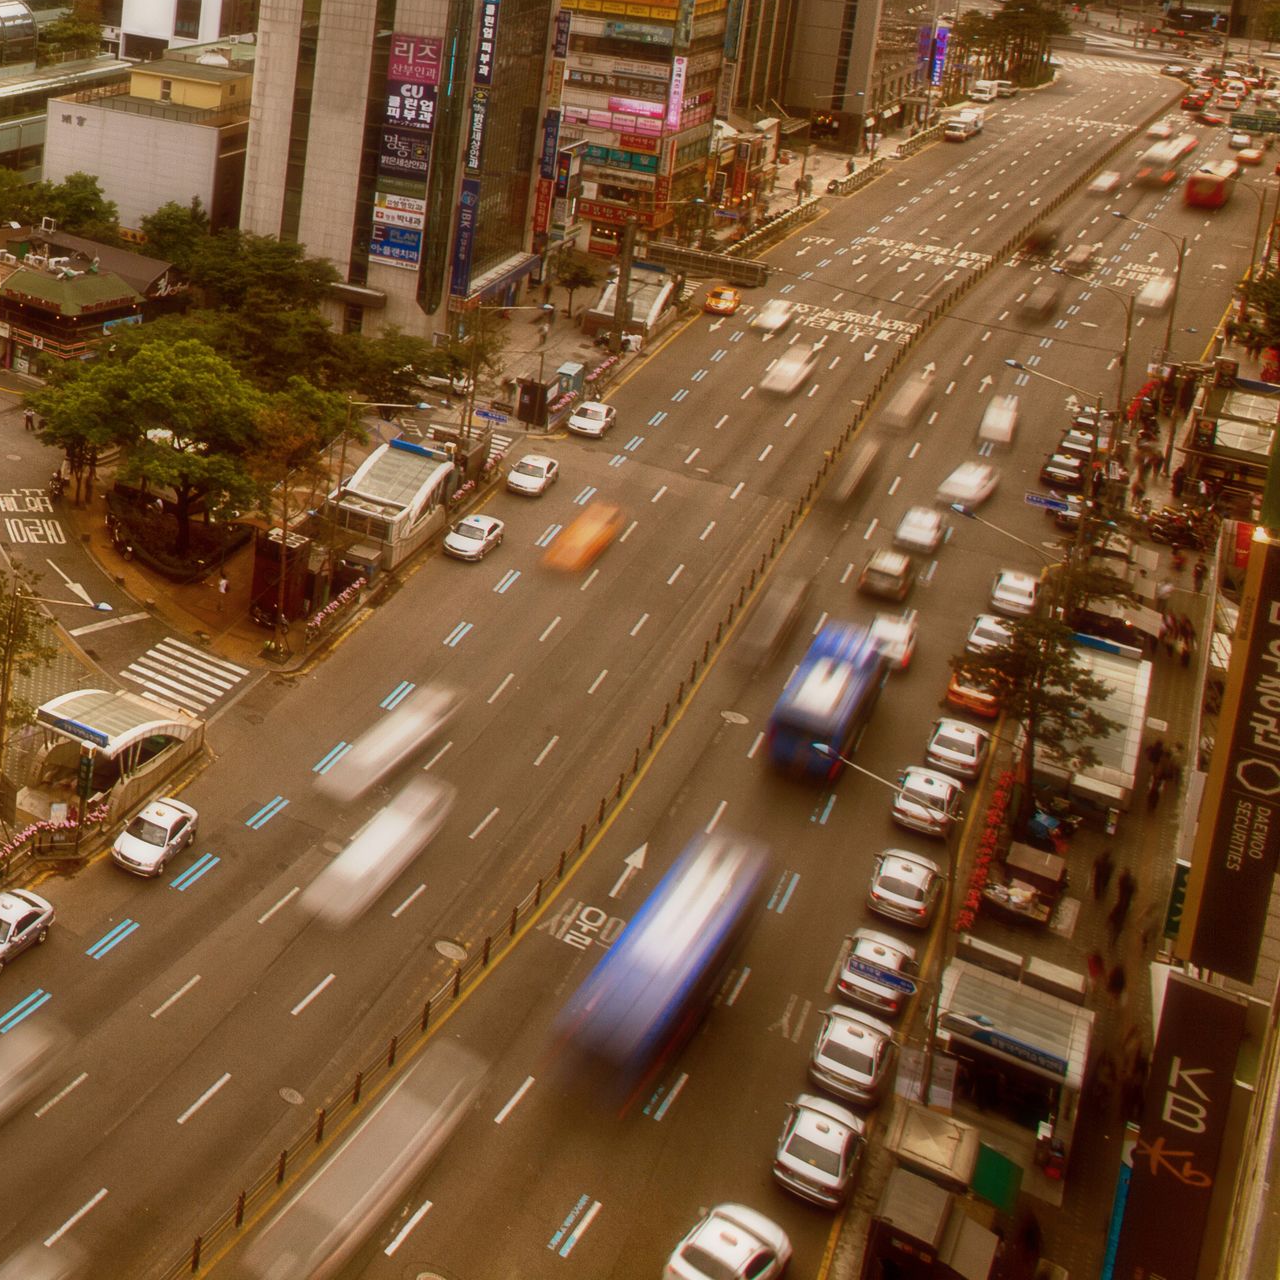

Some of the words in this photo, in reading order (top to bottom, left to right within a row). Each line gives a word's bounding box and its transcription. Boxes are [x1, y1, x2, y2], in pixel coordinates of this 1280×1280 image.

[394, 41, 438, 65] 리즈
[391, 63, 437, 81] 산부인과
[400, 83, 425, 99] CU
[386, 106, 434, 124] 피부과
[388, 95, 434, 113] 클린업
[384, 134, 412, 158] 명동
[4, 518, 67, 545] 어린이
[1226, 800, 1253, 872] SECURITIES
[1248, 805, 1272, 860] DAEWOO
[1161, 1055, 1216, 1134] KB
